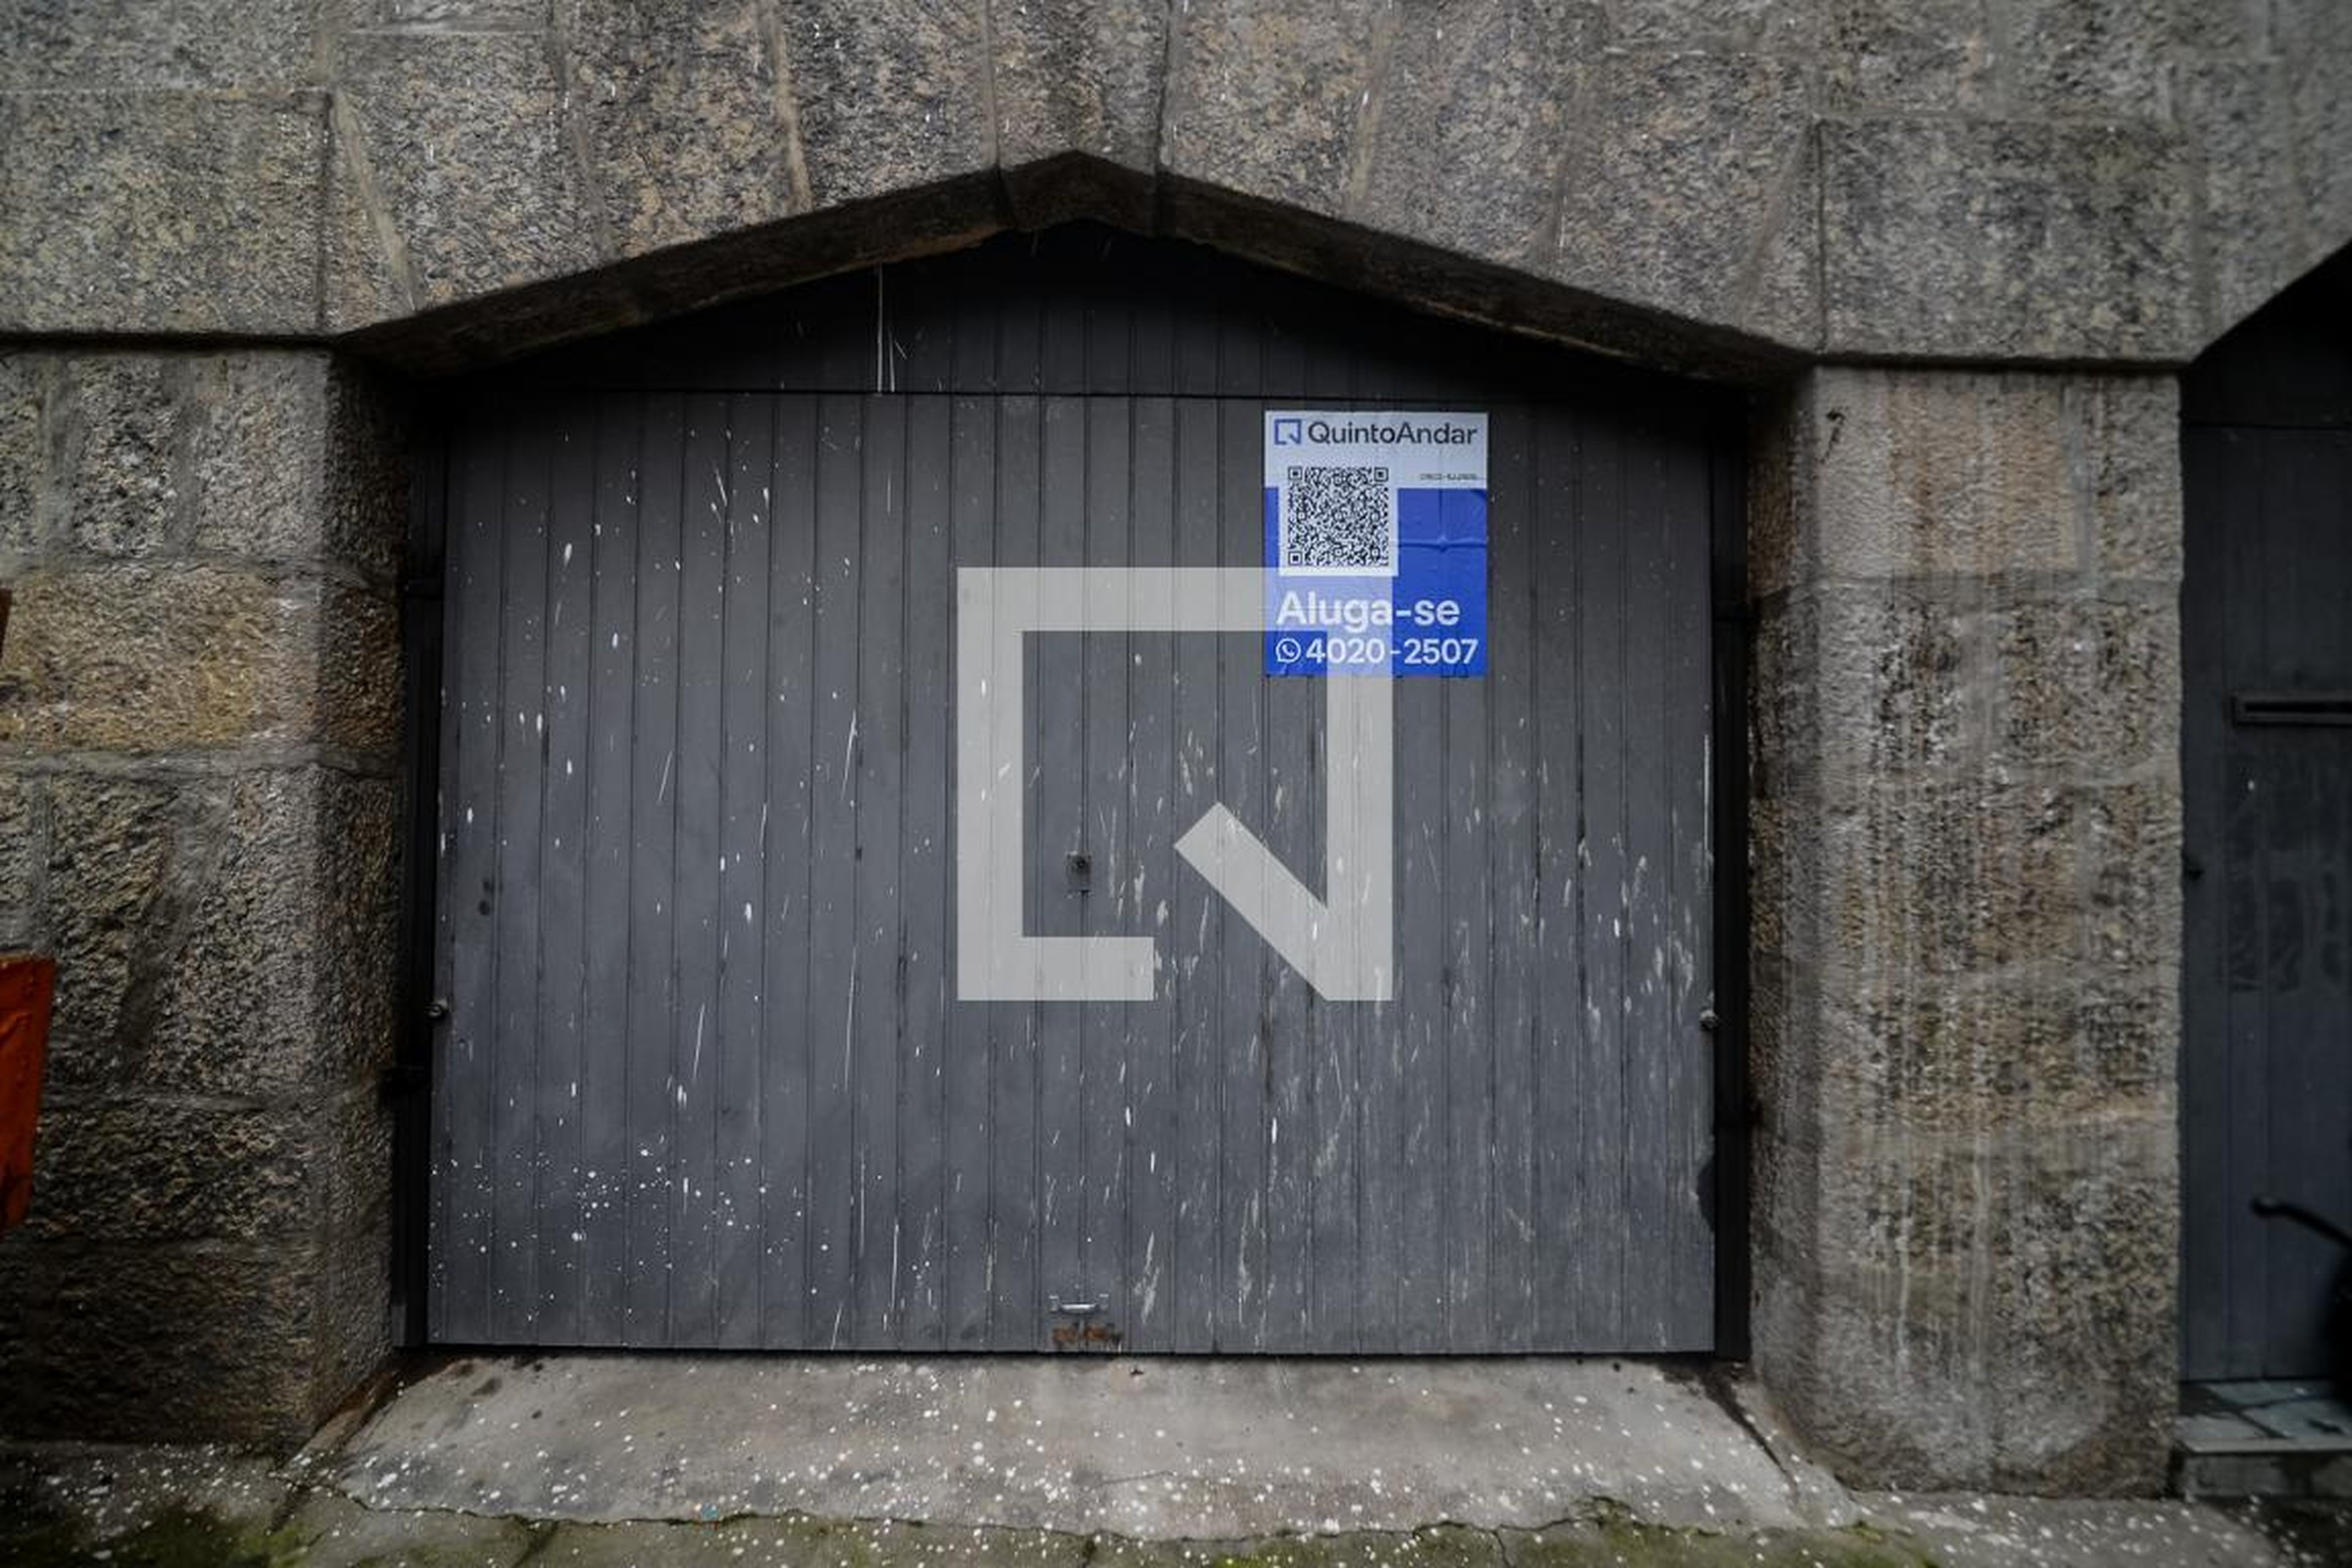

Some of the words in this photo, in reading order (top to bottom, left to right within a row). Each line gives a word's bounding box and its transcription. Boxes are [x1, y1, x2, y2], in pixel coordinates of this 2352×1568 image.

[1308, 421, 1477, 444] QuintoAndar
[1276, 591, 1460, 633] Aluga-se
[1306, 638, 1479, 664] 4020-2507
